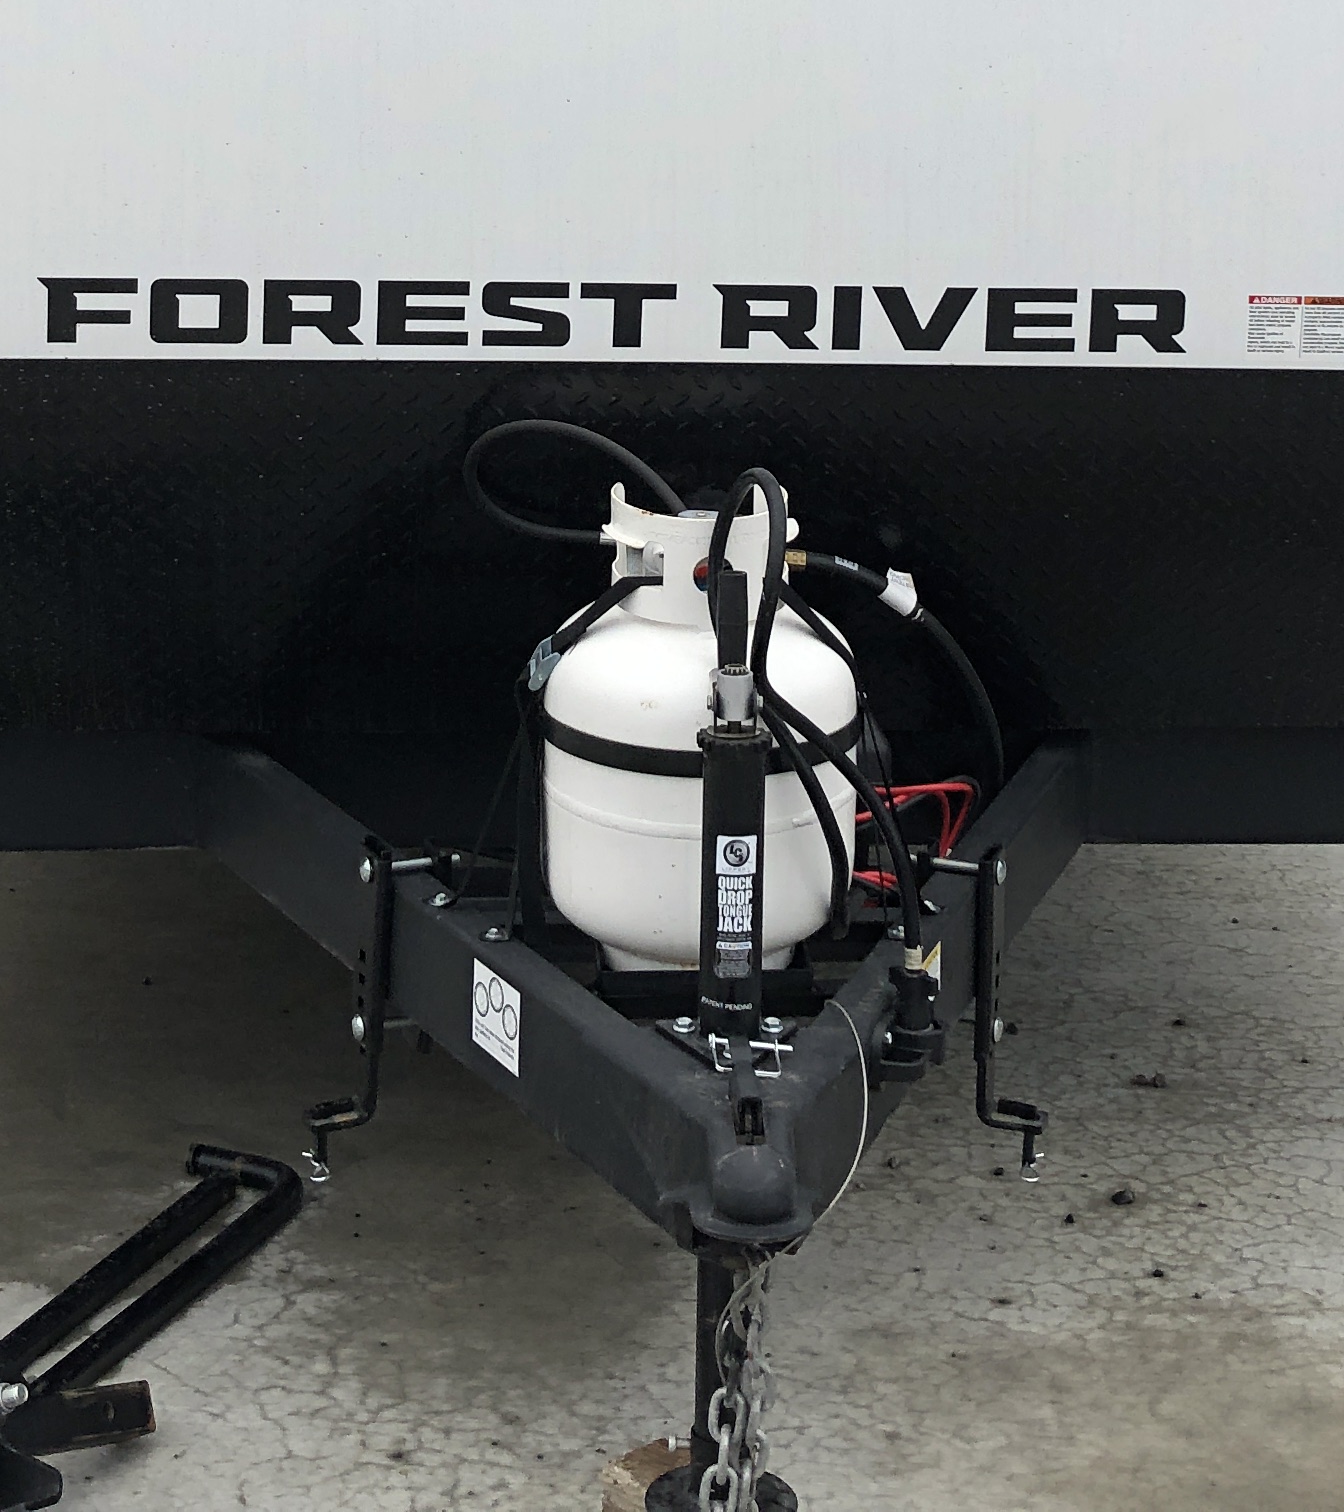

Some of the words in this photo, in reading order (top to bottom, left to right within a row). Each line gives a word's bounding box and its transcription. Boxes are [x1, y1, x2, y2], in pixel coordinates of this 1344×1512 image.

[37, 277, 677, 348] FOREST
[712, 283, 1187, 354] RIVER
[718, 875, 753, 890] QUICK
[718, 889, 753, 905] DROP
[718, 903, 753, 918] TONGUE
[717, 916, 753, 933] JACK
